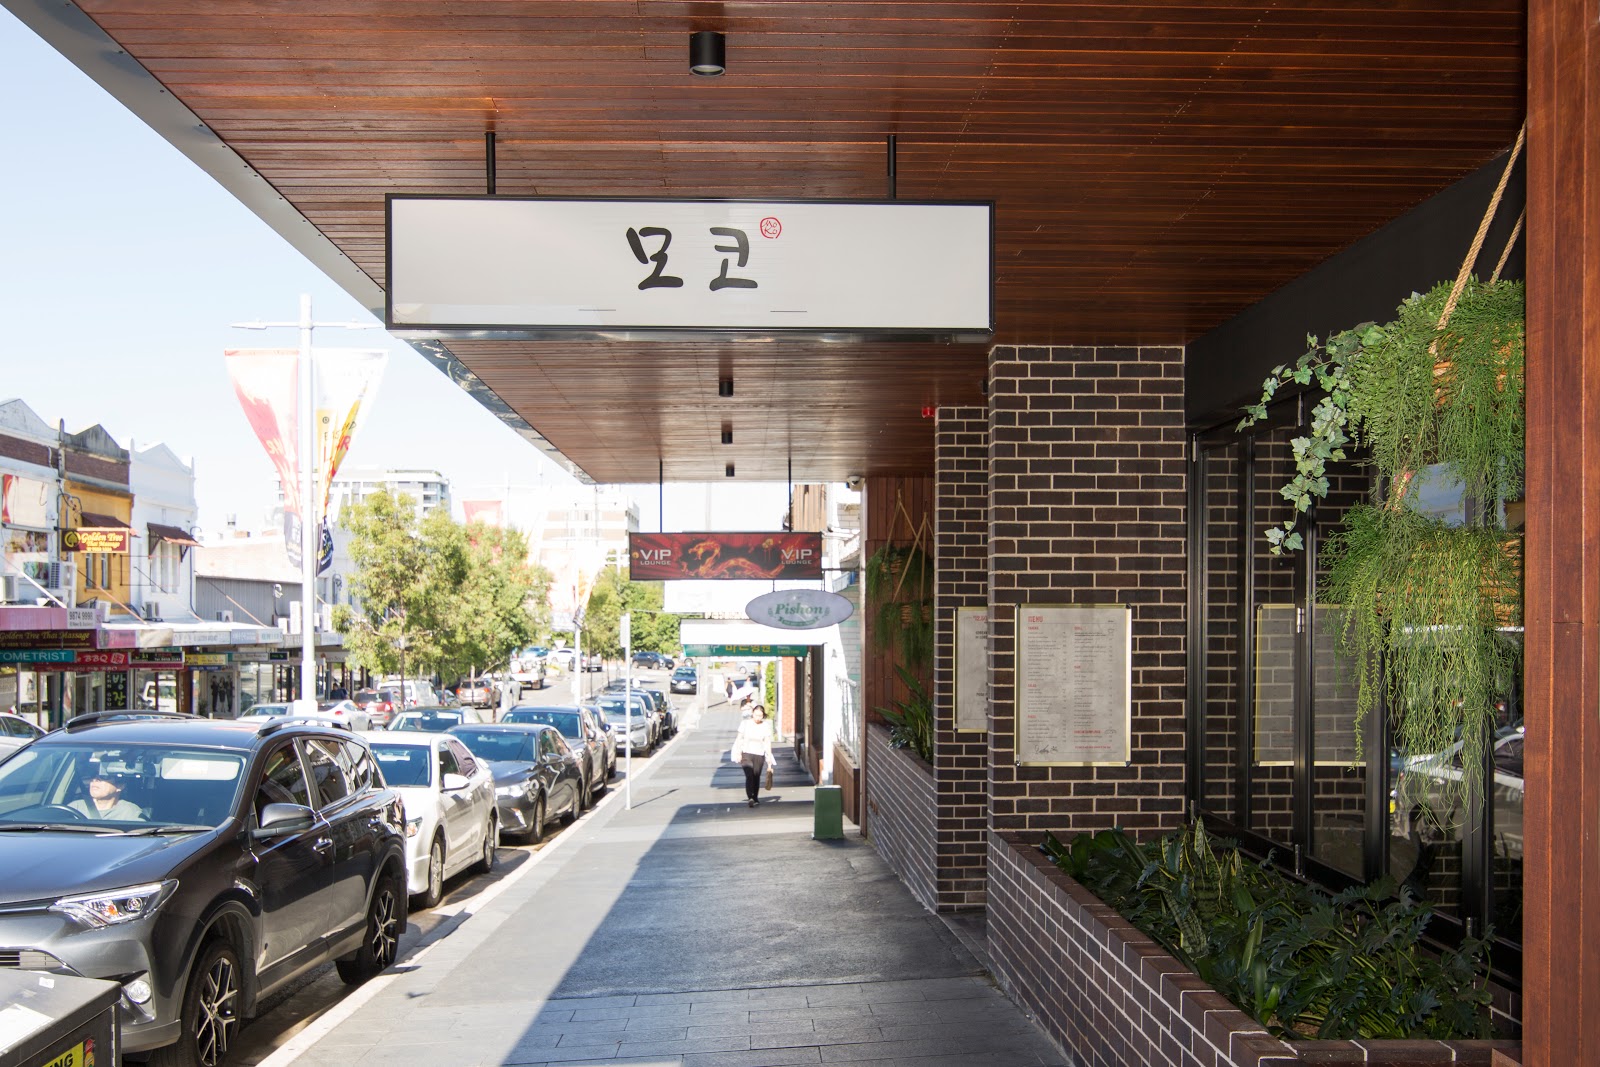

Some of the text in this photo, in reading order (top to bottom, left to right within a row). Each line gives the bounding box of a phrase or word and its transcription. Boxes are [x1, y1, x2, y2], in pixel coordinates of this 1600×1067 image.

[81, 532, 124, 543] Golden Tree
[640, 549, 813, 560] VIP VIP
[0, 632, 90, 641] Golden Tree Thai Massage
[84, 655, 108, 663] BBQ
